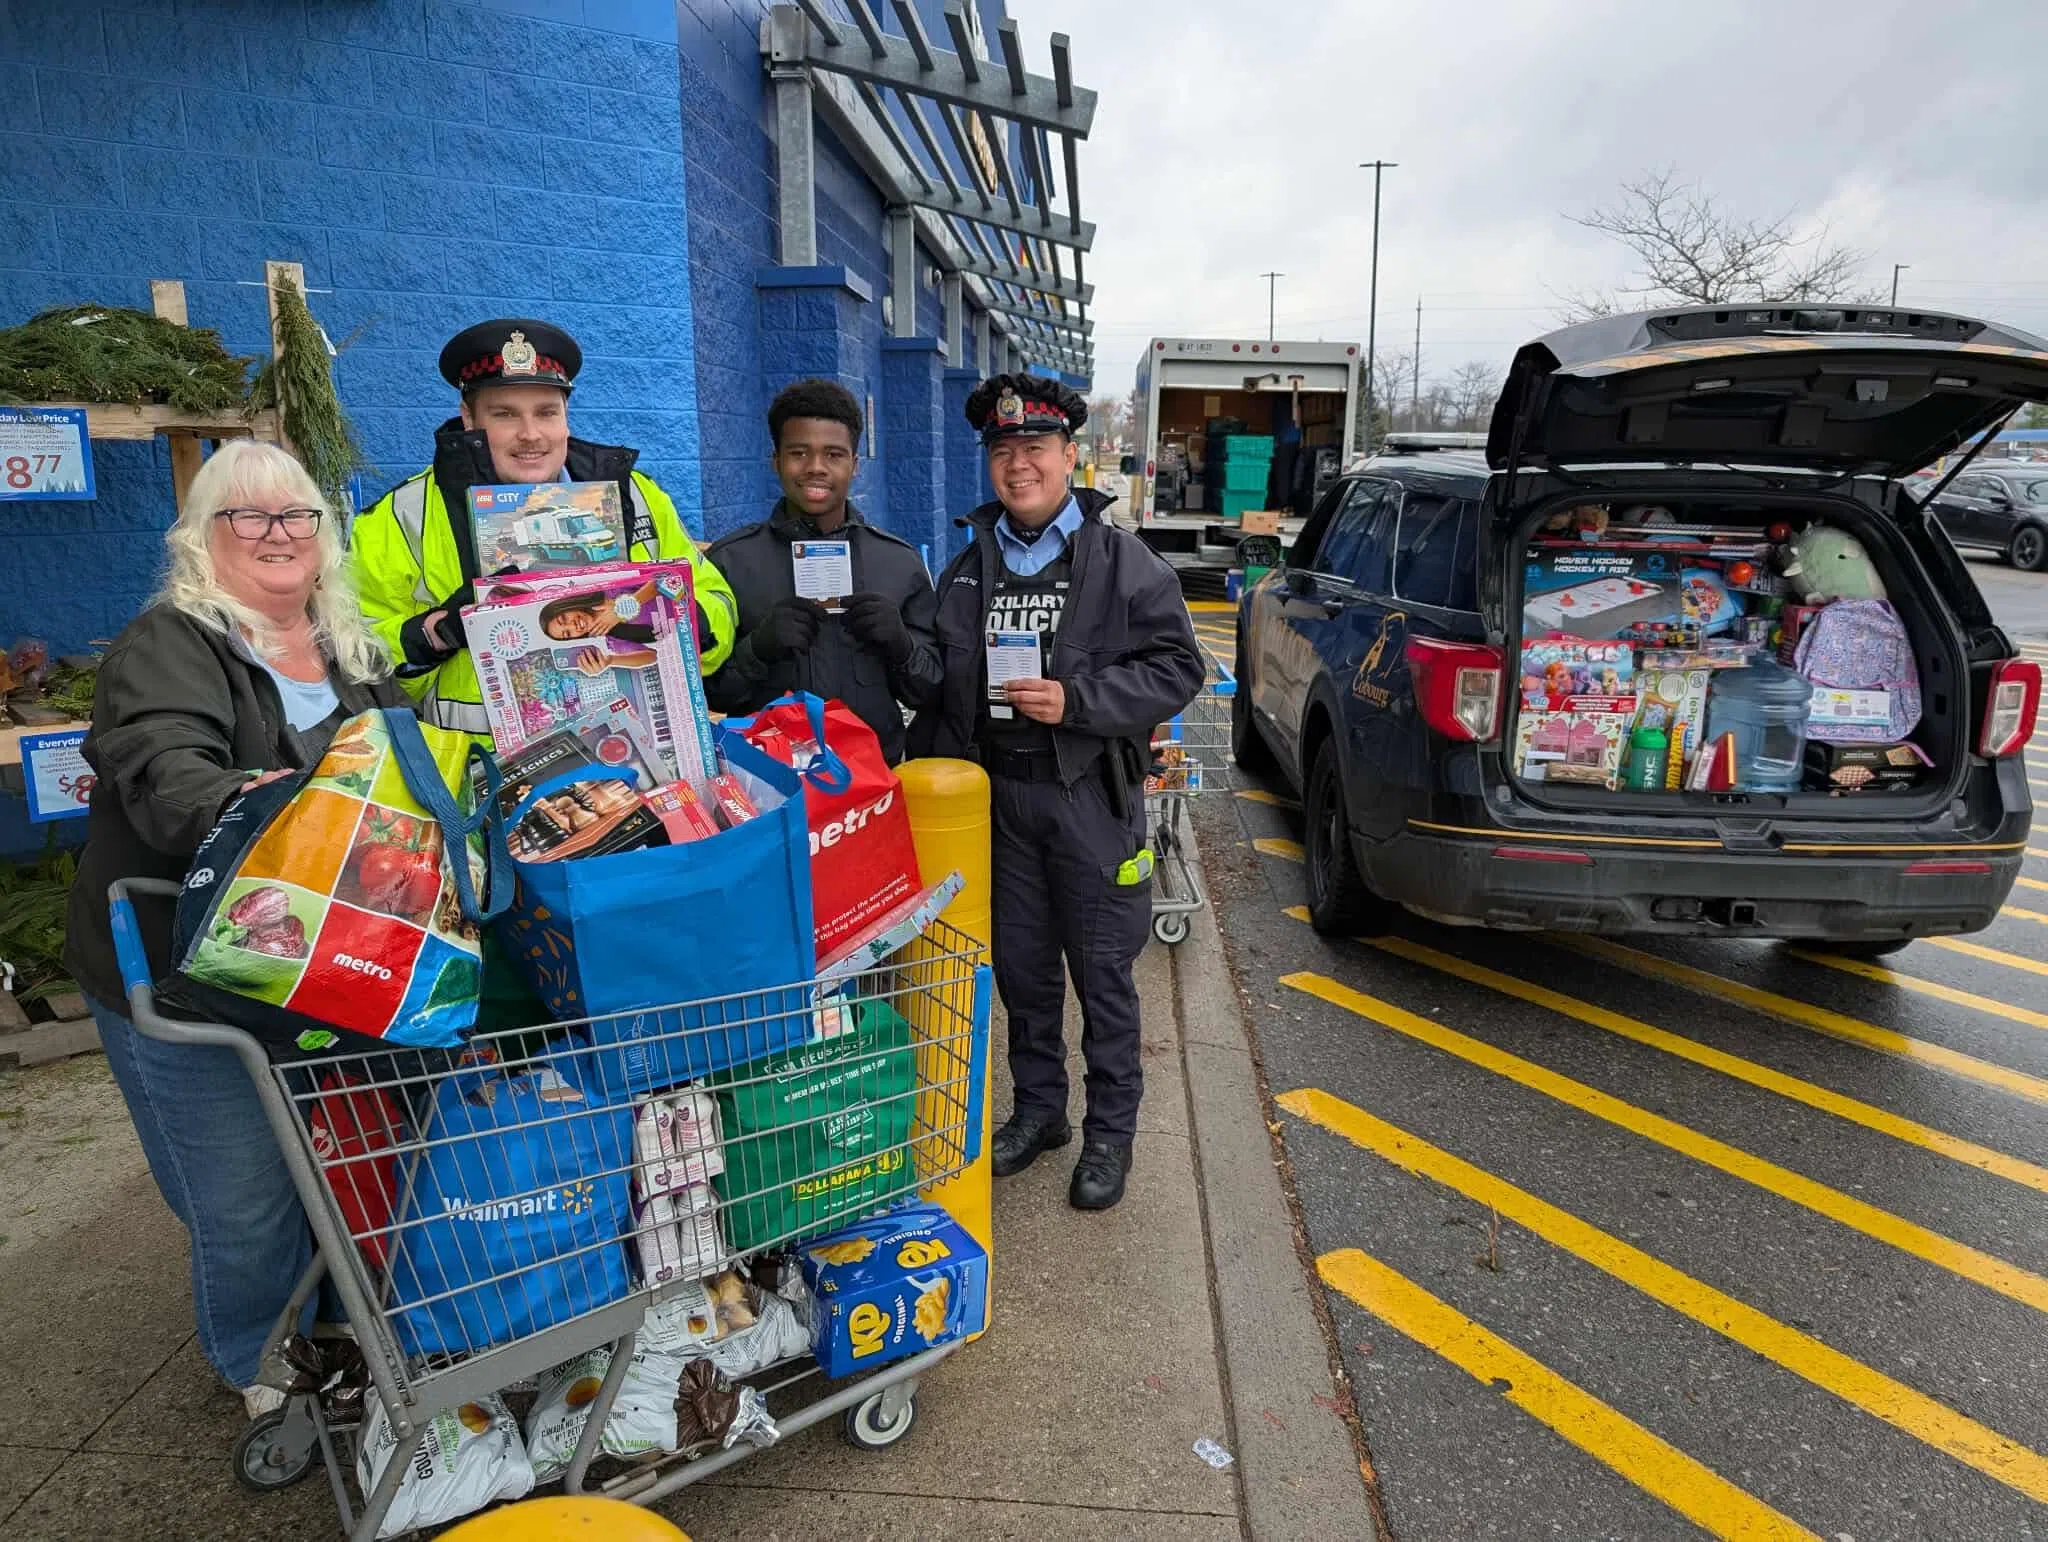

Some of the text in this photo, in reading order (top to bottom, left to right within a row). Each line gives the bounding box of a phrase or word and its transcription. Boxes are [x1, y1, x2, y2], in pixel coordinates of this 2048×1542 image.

[43, 415, 70, 423] Price
[497, 493, 520, 503] CITY
[991, 594, 1066, 609] XILIARY
[987, 610, 1062, 632] OLIC
[820, 931, 834, 940] this
[834, 923, 849, 932] bag
[849, 912, 865, 924] each
[866, 902, 881, 914] time
[881, 894, 894, 904] you
[831, 908, 857, 927] protect
[857, 900, 868, 909] the
[332, 952, 393, 981] metro
[797, 1164, 872, 1194] DOLLARAMA
[443, 1190, 557, 1222] Walmart
[894, 1294, 907, 1344] ORIGINAL
[541, 1422, 565, 1438] CANADA
